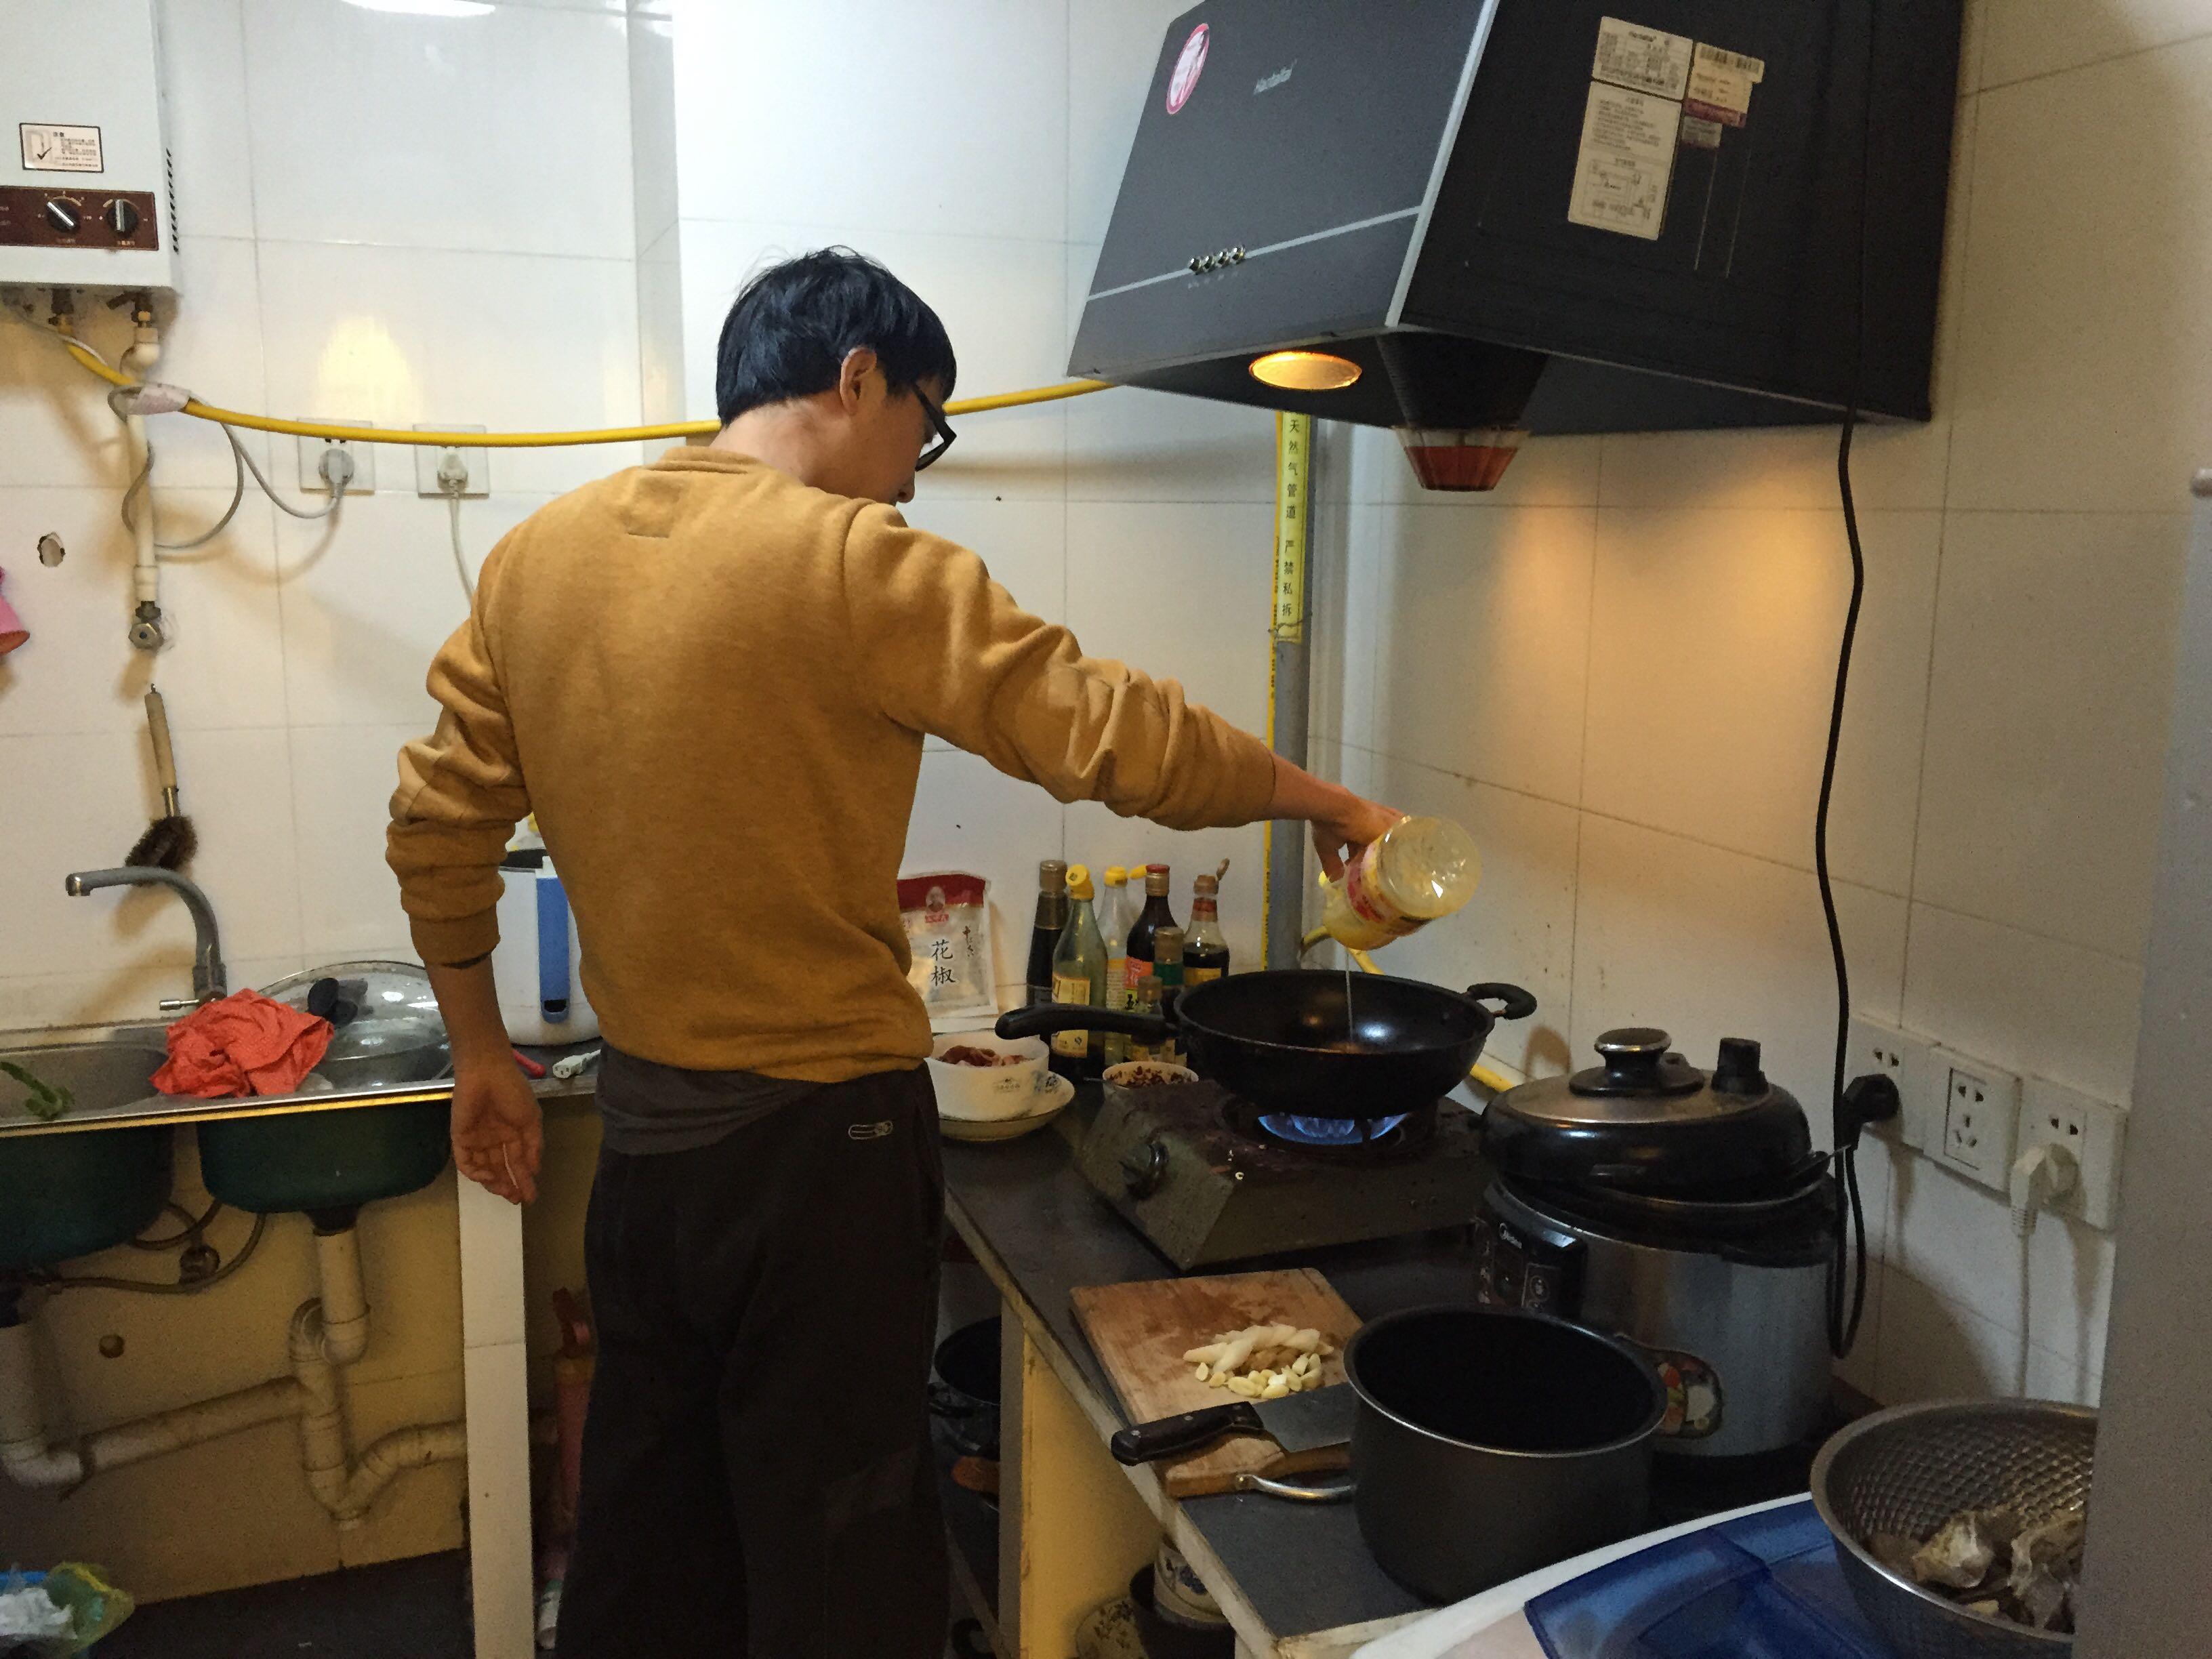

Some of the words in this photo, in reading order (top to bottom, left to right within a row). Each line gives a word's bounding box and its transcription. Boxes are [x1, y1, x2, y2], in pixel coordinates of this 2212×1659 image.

[1286, 419, 1300, 520] 天然气管道
[1282, 540, 1294, 617] 严禁私拆
[931, 939, 956, 987] 花椒
